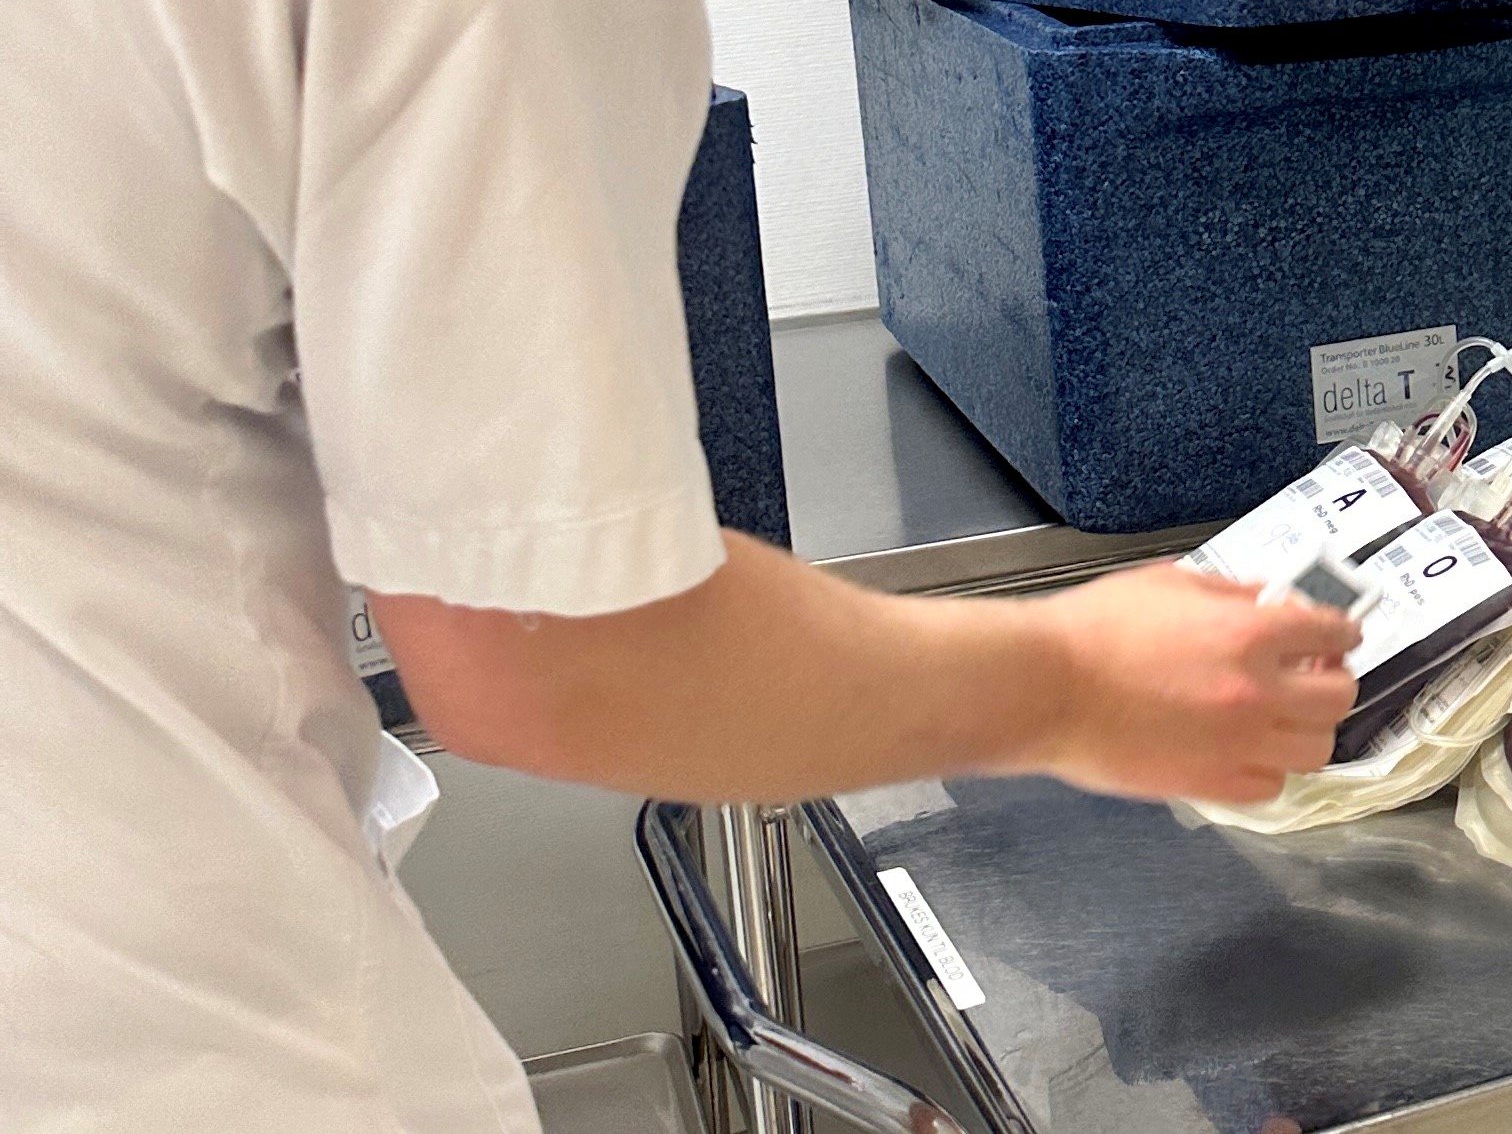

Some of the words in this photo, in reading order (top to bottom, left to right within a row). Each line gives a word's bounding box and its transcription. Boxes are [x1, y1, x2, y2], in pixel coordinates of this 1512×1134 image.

[1320, 346, 1377, 365] Transporter
[1378, 339, 1421, 355] BlueLine
[1424, 333, 1445, 347] 30L
[1323, 377, 1387, 415] delta
[1397, 369, 1415, 400] T
[1332, 488, 1367, 512] A
[1325, 520, 1339, 535] neg
[1423, 556, 1458, 578] O
[1409, 589, 1426, 606] pos
[938, 955, 966, 982] BLOD
